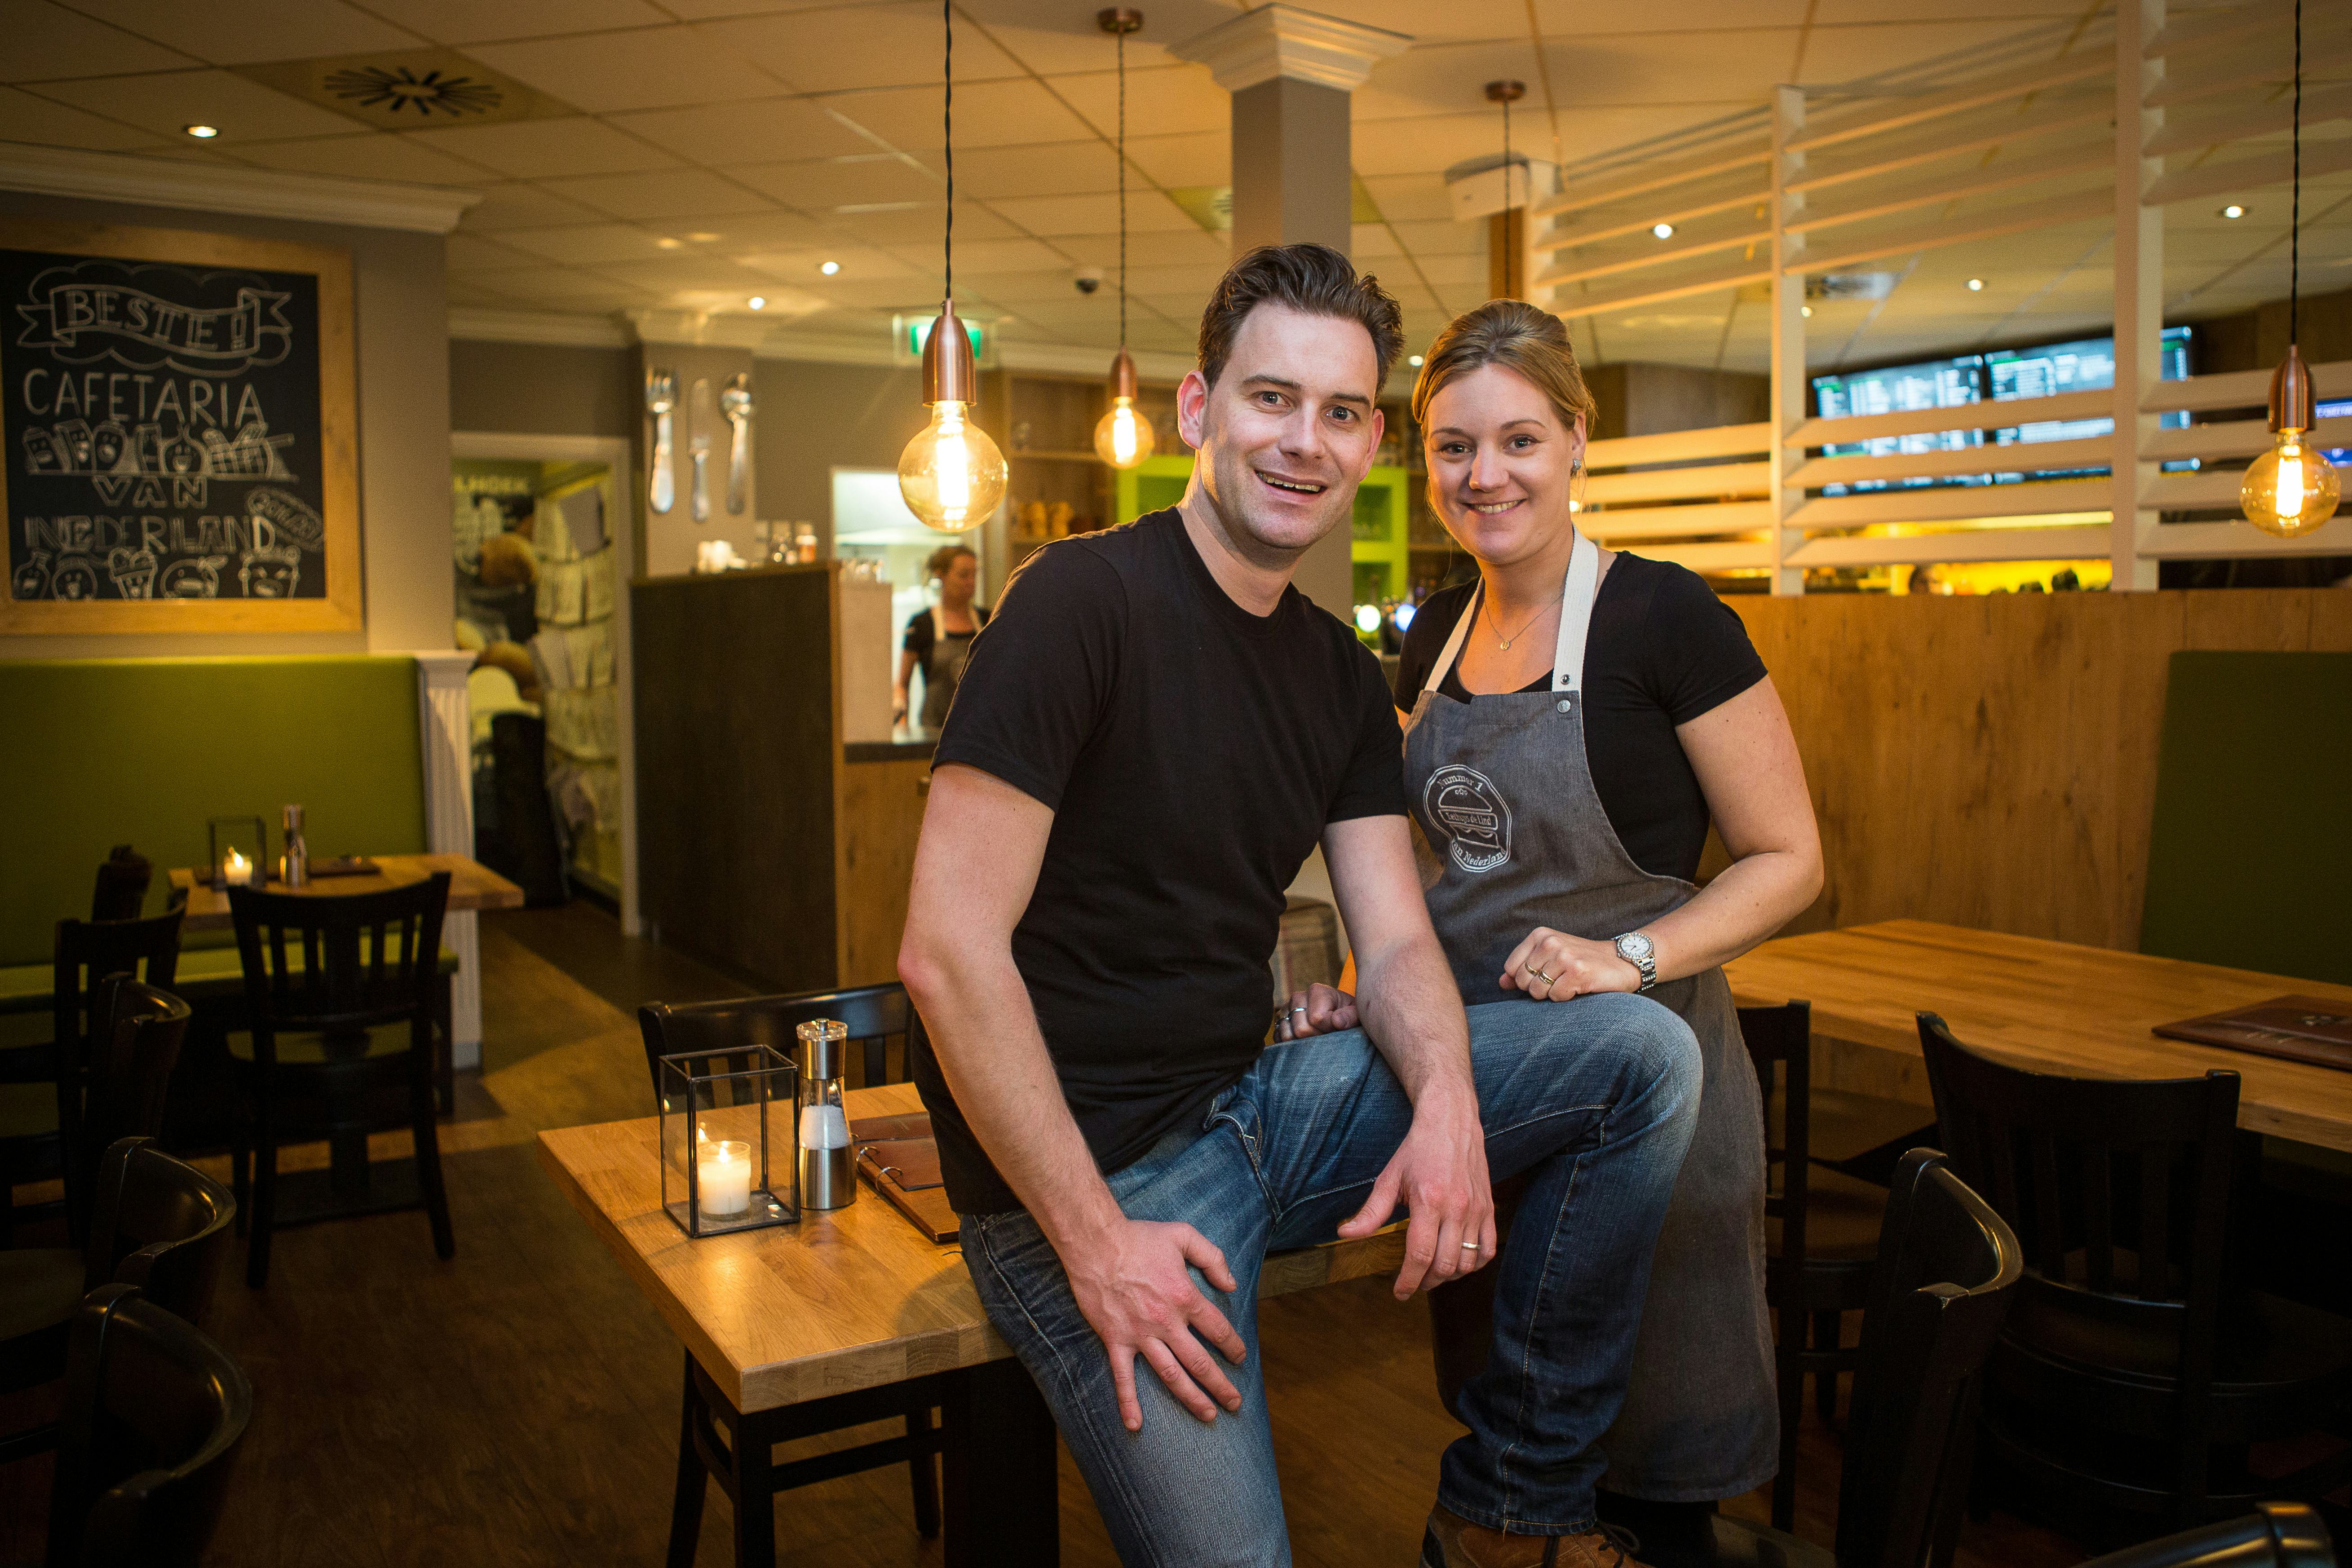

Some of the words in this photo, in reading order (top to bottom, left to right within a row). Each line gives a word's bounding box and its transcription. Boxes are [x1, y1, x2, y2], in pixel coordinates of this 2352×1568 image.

[23, 368, 268, 429] CAFETARIA
[92, 475, 208, 508] VAN
[24, 514, 277, 554] NEDERLAND
[1437, 775, 1474, 789] Nummer
[1474, 782, 1483, 792] 1
